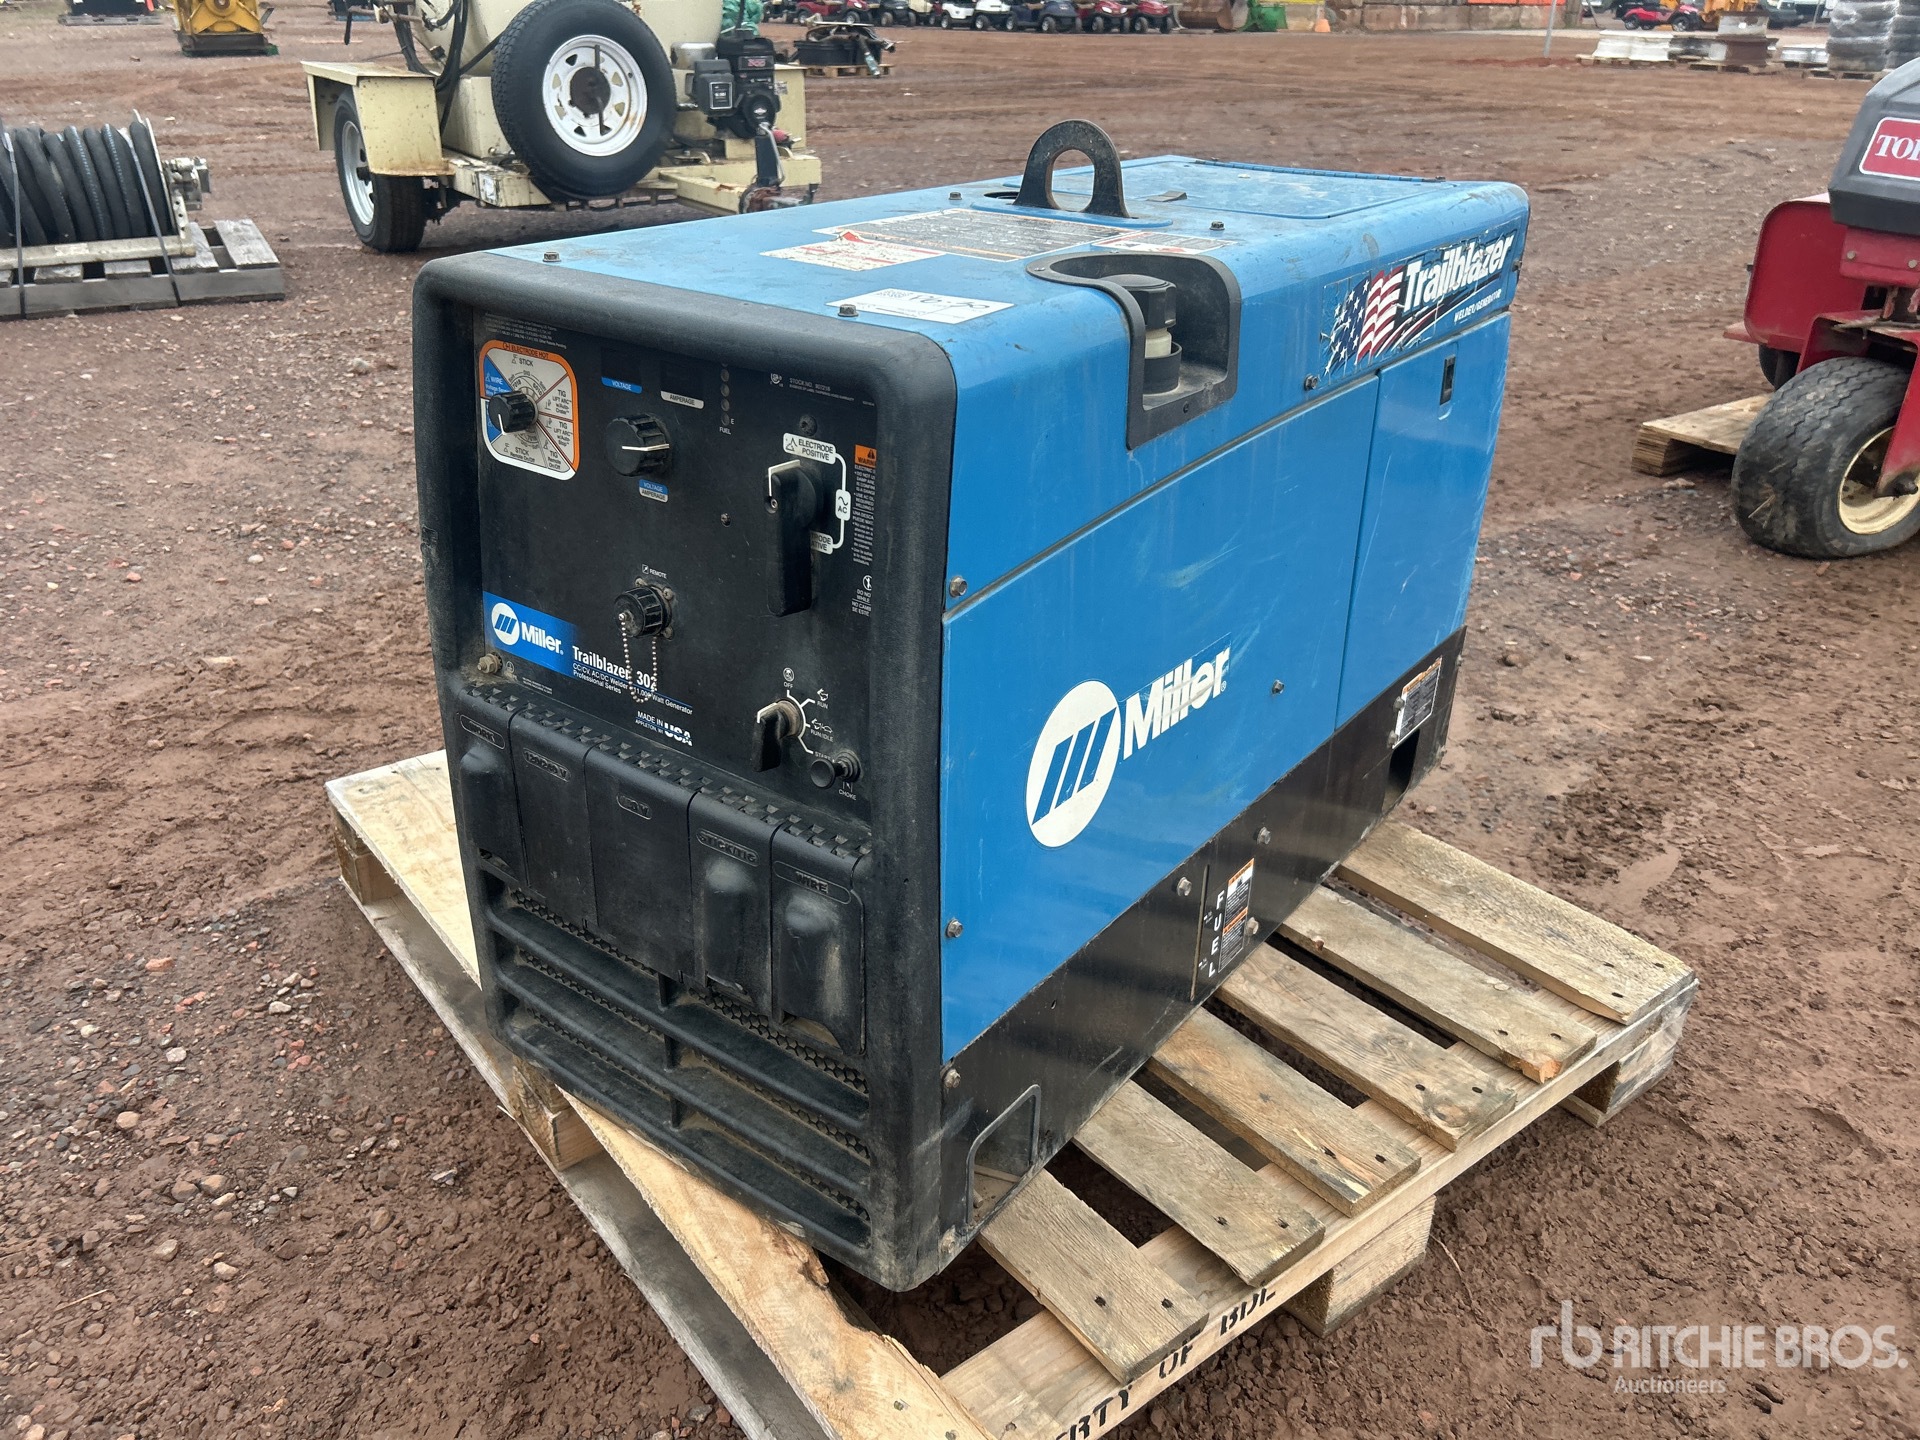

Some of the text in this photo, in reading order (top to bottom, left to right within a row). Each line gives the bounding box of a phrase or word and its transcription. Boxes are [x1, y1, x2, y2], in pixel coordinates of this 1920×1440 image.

[1404, 235, 1514, 312] Trailblazer
[512, 344, 548, 359] ELECTRODE HOT
[519, 358, 533, 366] STICK
[491, 376, 503, 385] WIRE
[612, 380, 631, 390] VOLTAGE
[558, 389, 566, 397] TIG
[670, 394, 695, 405] AMPERAGE
[559, 421, 567, 429] TIG
[720, 427, 731, 435] FUEL
[515, 447, 529, 456] STICK
[799, 439, 833, 454] ELECTRODE
[550, 450, 558, 458] TIG
[802, 448, 829, 461] POSITIVE
[857, 457, 876, 466] WARN
[644, 482, 663, 492] VOLTAGE
[642, 489, 665, 500] AMPERAGE
[838, 505, 847, 514] AC
[650, 567, 667, 579] REMOTE
[521, 621, 562, 654] Miller
[572, 645, 657, 692] Trailblazer 302
[573, 670, 621, 694] Professional Series
[784, 681, 793, 689] OFF
[610, 677, 628, 689] Welder
[652, 693, 664, 704] Watt
[665, 699, 693, 715] Generator
[817, 701, 828, 709] RUN
[1123, 646, 1230, 760] Miller
[637, 711, 664, 727] MADE IN
[664, 722, 692, 746] USA
[810, 729, 834, 742] RUN/IDLE
[839, 789, 857, 800] CHOKE
[795, 871, 828, 894] WIRE
[1209, 890, 1224, 978] FUEL
[1159, 1329, 1202, 1379] OF
